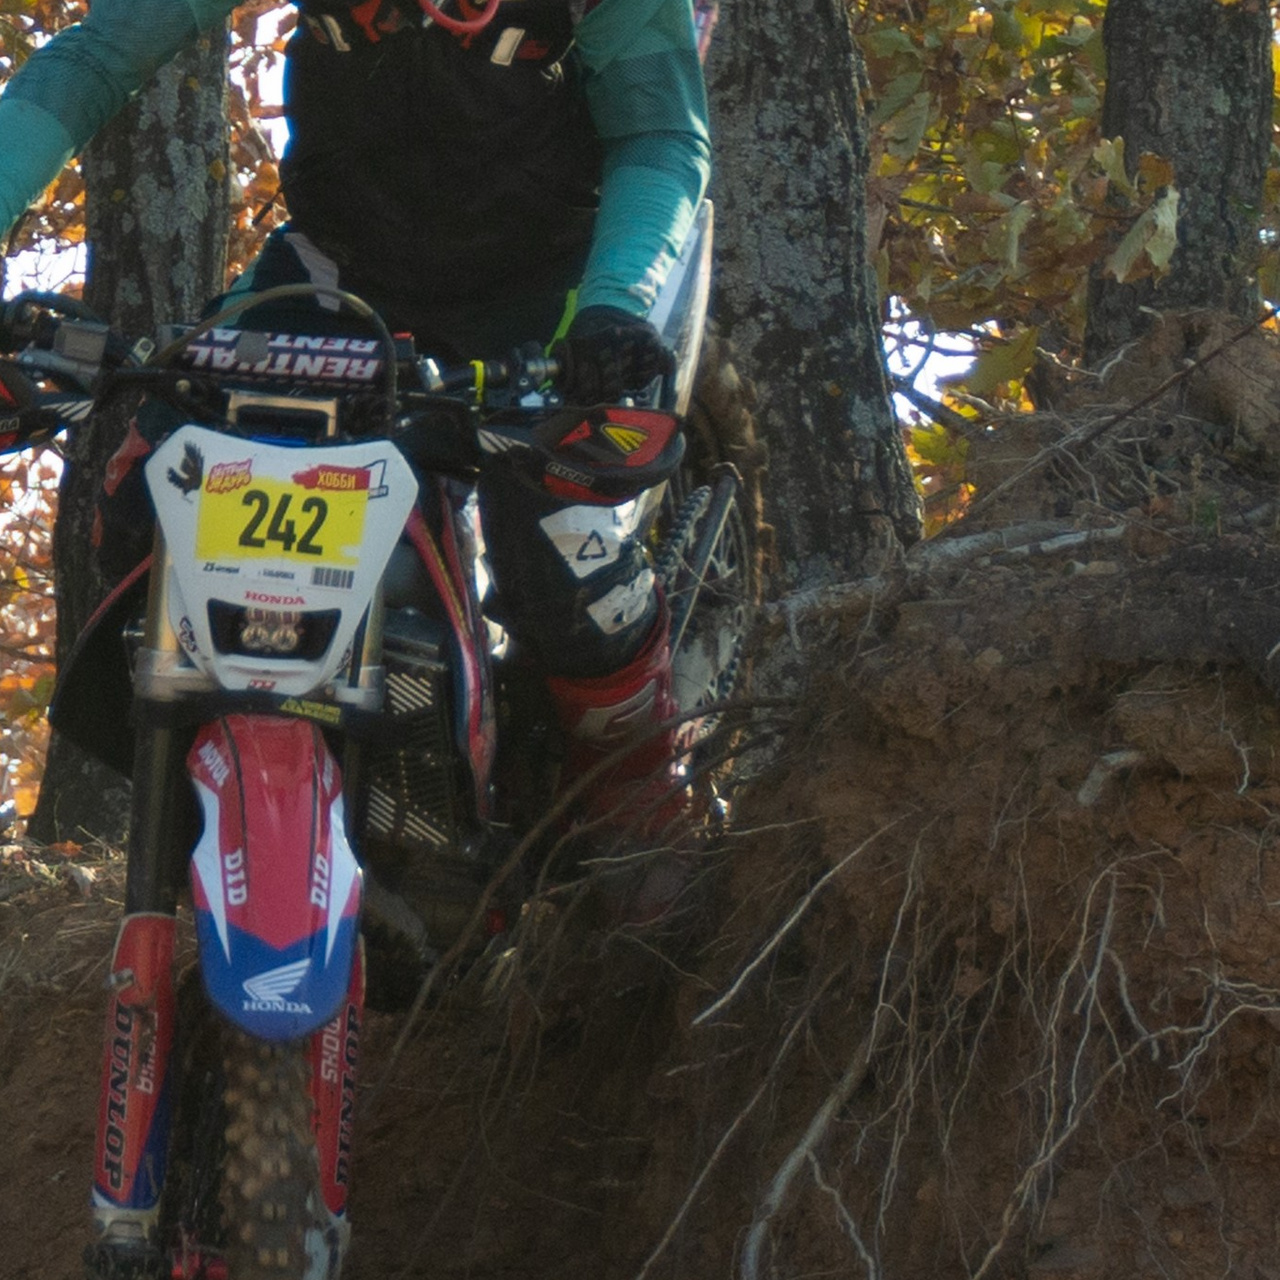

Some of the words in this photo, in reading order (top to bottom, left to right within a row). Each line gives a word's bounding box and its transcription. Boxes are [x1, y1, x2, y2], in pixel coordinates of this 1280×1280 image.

[199, 328, 380, 353] RENTA
[317, 472, 356, 489] ХОББИ
[238, 489, 328, 556] 242
[244, 590, 307, 605] HONDA
[224, 847, 248, 907] DID
[243, 1000, 313, 1014] HONDA
[103, 998, 135, 1192] DUNLOP
